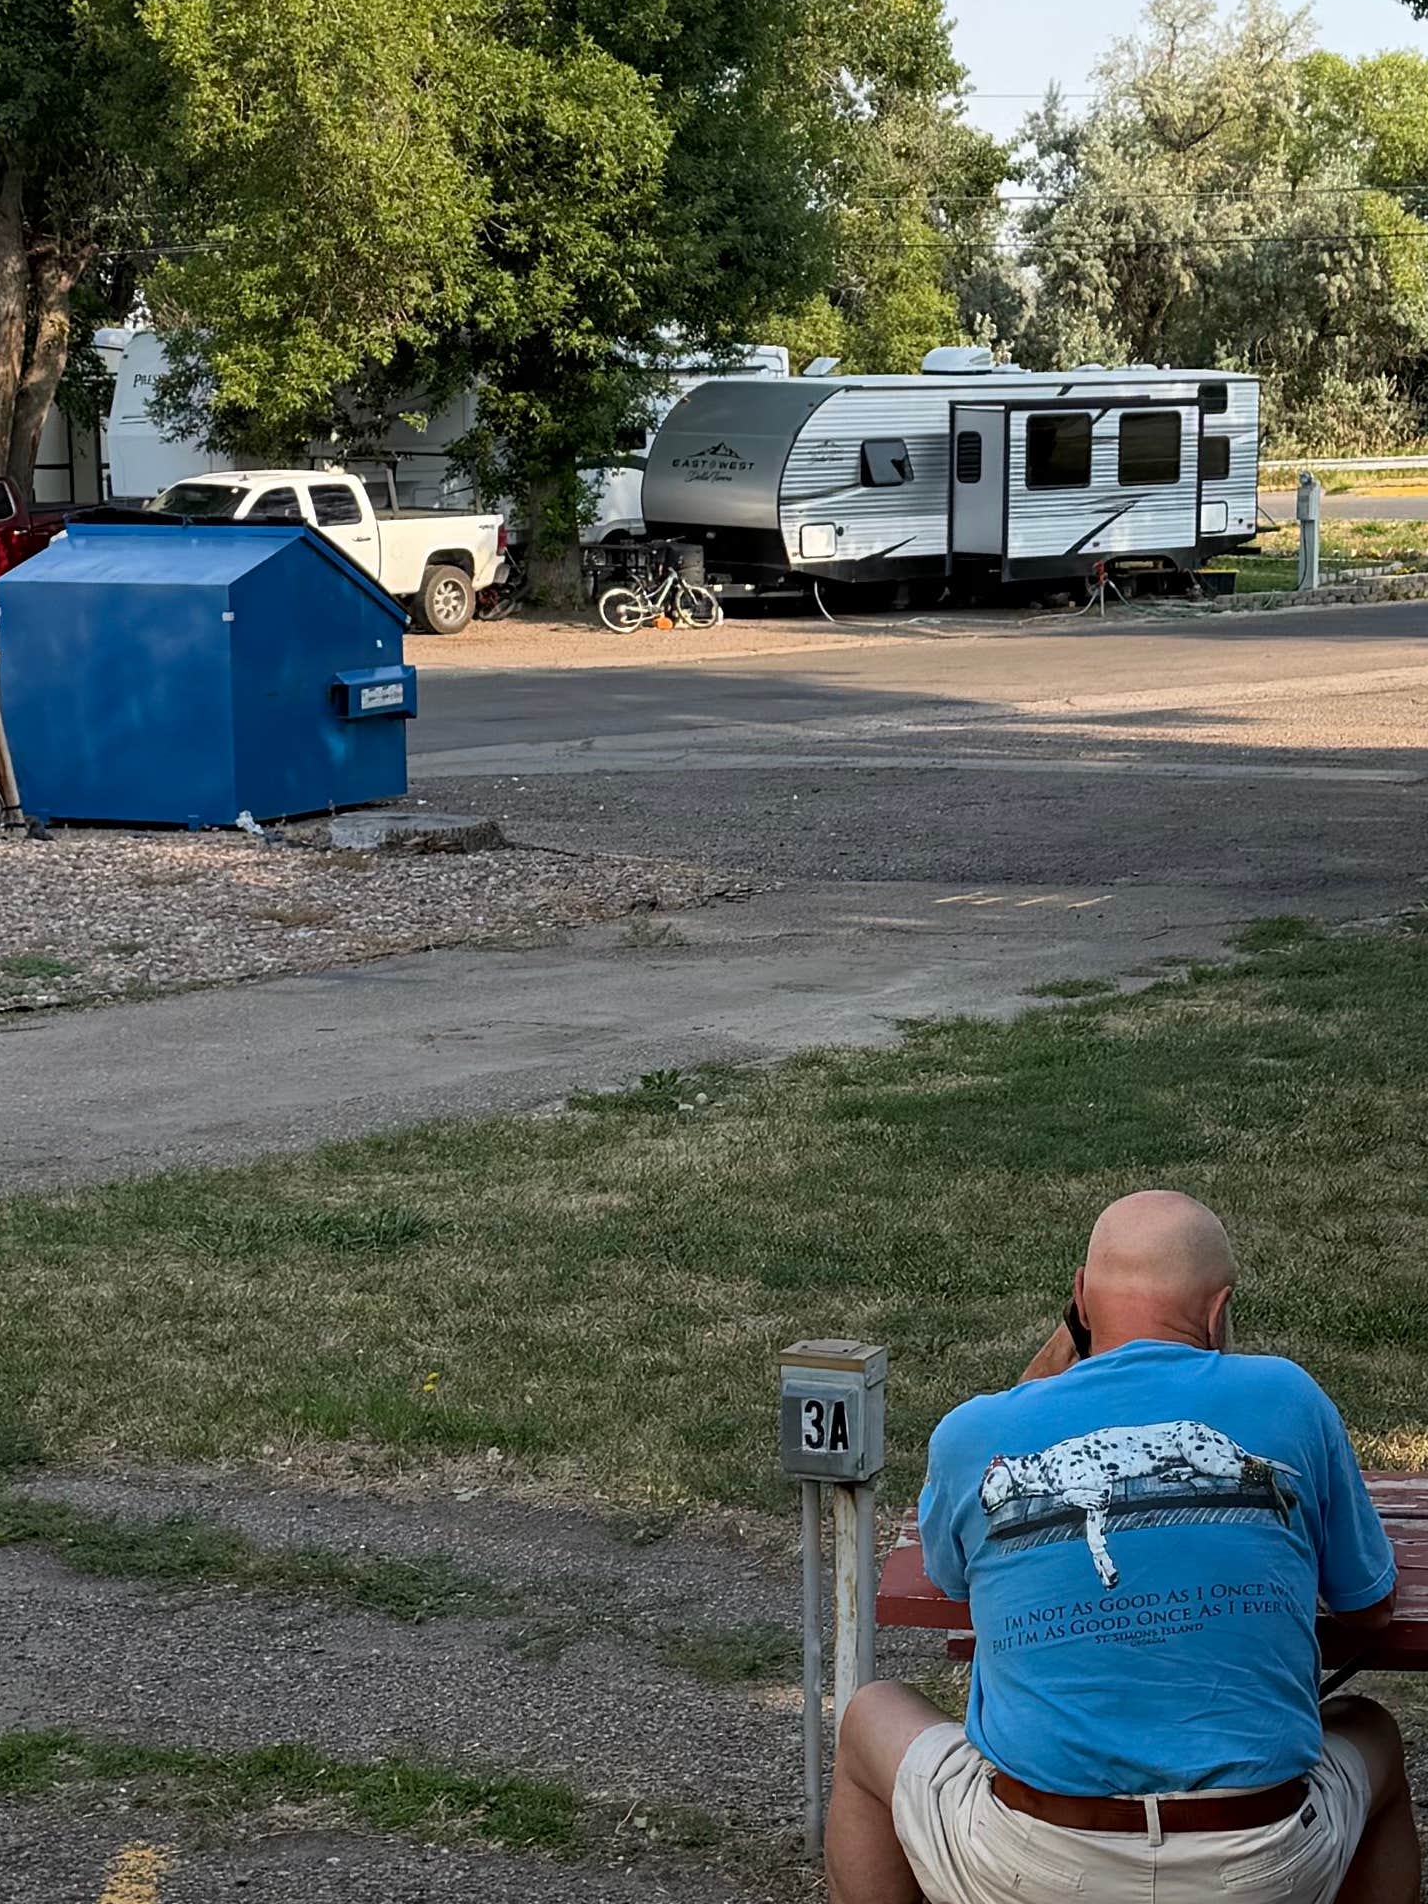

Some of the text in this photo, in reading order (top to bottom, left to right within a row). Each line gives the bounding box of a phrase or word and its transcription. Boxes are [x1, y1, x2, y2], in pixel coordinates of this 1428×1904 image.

[672, 458, 708, 469] EAST
[719, 461, 755, 471] WEST
[804, 1399, 849, 1451] 3A
[1028, 1606, 1066, 1625] NOT
[1071, 1601, 1093, 1617] AS
[1099, 1593, 1161, 1613] GOOD
[1166, 1589, 1189, 1605] AS
[1197, 1586, 1203, 1601] I
[1211, 1583, 1265, 1599] ONCE
[992, 1636, 1014, 1655] BUT
[1044, 1624, 1065, 1641] AS
[1070, 1616, 1131, 1635] GOOD
[1137, 1608, 1192, 1626] ONCE
[1199, 1604, 1222, 1618] AS
[1229, 1600, 1234, 1615] I
[1243, 1600, 1283, 1615] EVER
[1161, 1623, 1204, 1636] ISLAND
